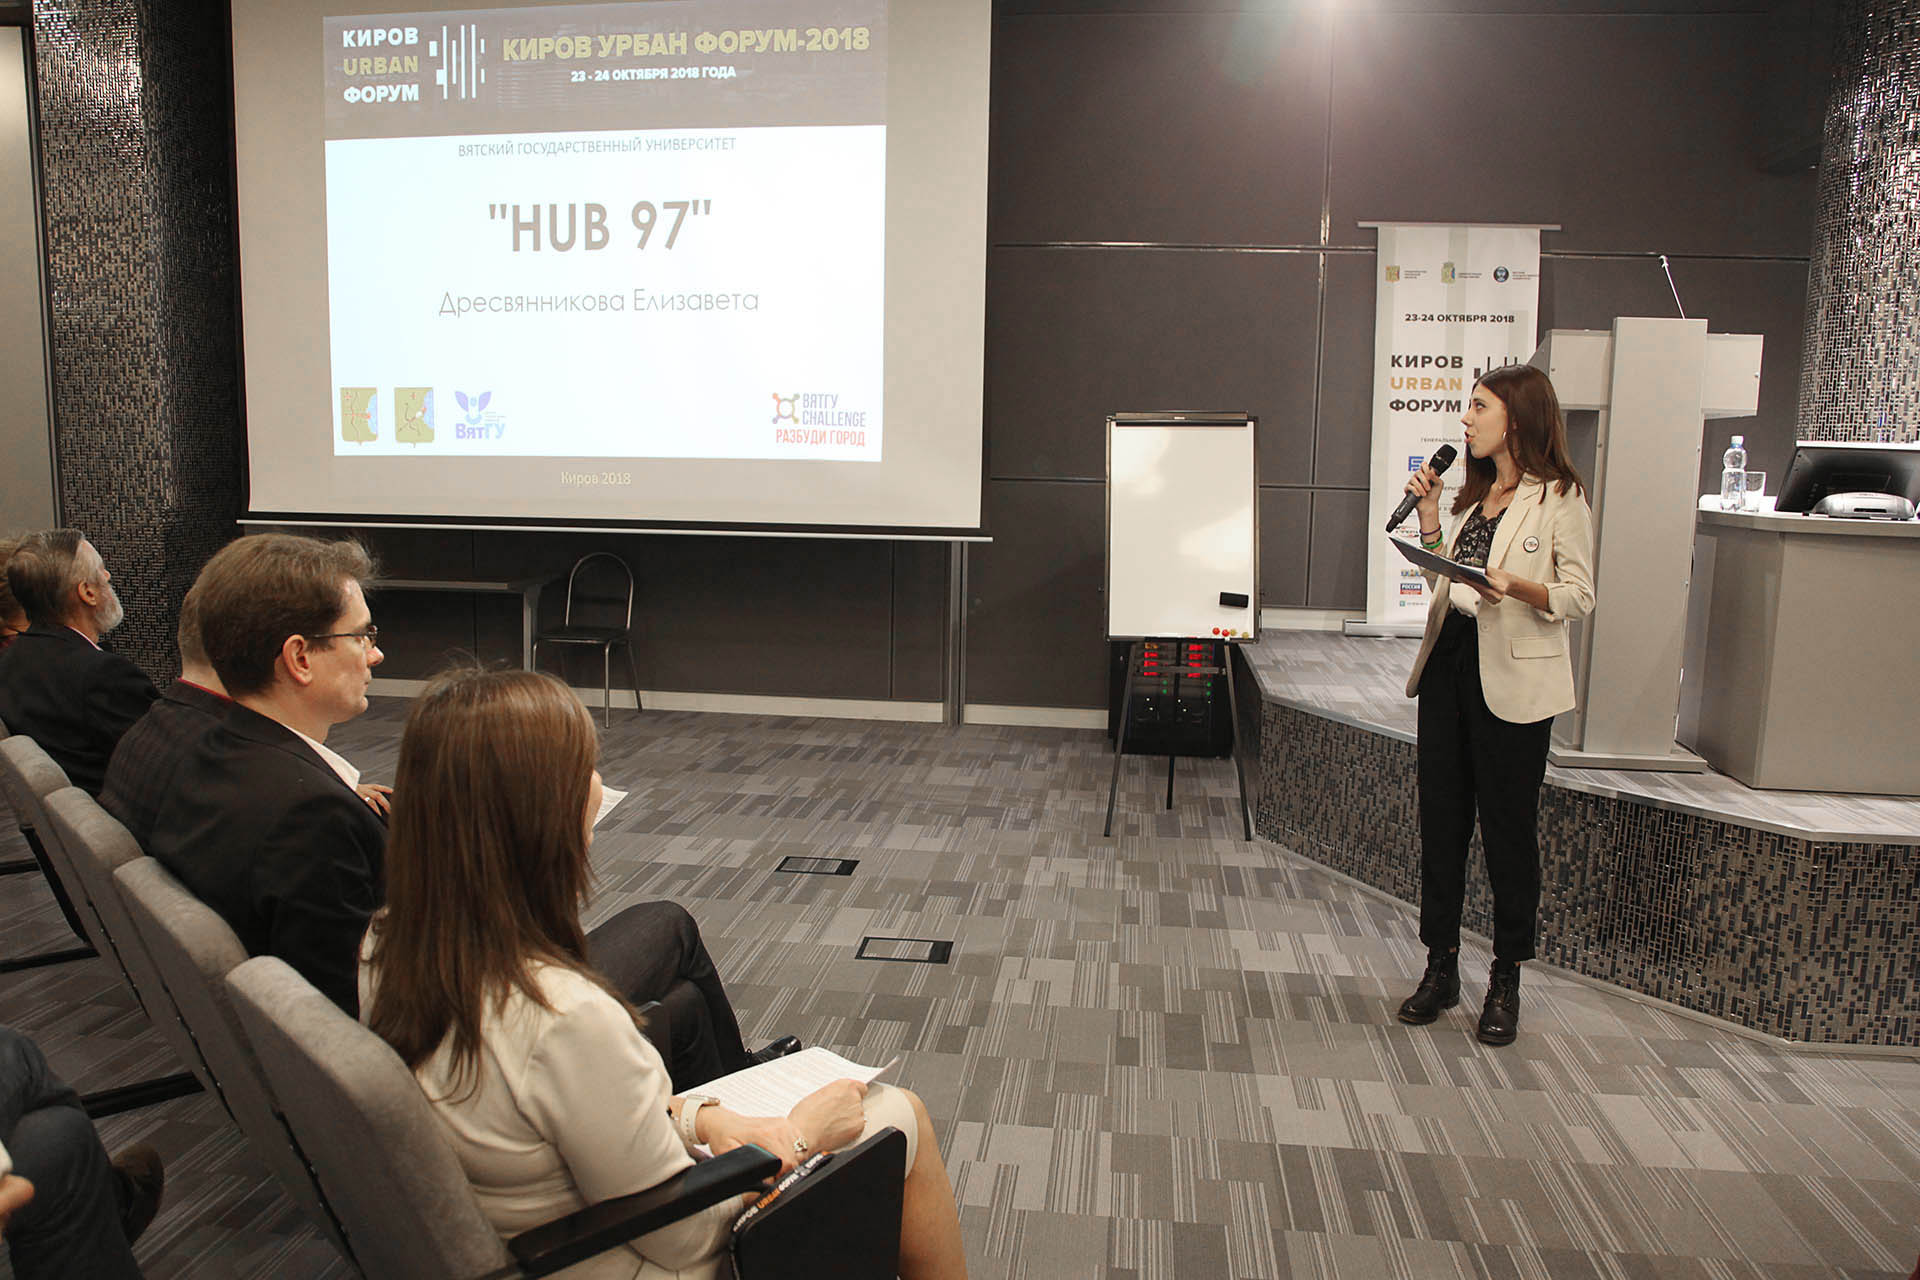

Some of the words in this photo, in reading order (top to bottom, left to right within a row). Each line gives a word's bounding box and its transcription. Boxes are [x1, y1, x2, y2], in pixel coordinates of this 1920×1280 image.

[343, 27, 419, 48] КИРОВ
[502, 38, 592, 61] КИРОВ
[598, 32, 687, 58] УРБАН
[694, 26, 871, 55] ФОРУМ-2018
[343, 55, 419, 76] URBAN
[570, 70, 586, 83] 23
[594, 69, 610, 82] 24
[612, 68, 669, 81] ОКТЯБРЯ
[670, 66, 700, 79] 2018
[702, 65, 737, 80] ГОДА
[343, 84, 420, 103] ФОРУМ
[458, 138, 515, 157] ВЯТСКИЙ
[517, 136, 642, 156] ГОСУДАРСТВЕННЫЙ
[646, 137, 737, 152] УНИВЕРСИТЕТ
[438, 291, 625, 318] Дресвянникова
[633, 288, 759, 312] Елизавета
[1404, 313, 1435, 323] 23-24
[1437, 313, 1487, 323] ОКТЯБРЯ
[1489, 314, 1516, 324] 2018
[1391, 355, 1464, 369] КИРОВ
[1390, 377, 1463, 391] URBAN
[802, 393, 839, 409] ВЯТГУ
[1389, 399, 1462, 413] ФОРУМ
[802, 410, 866, 428] CHALLENGE
[455, 423, 505, 440] ВятГУ
[776, 428, 826, 445] РАЗБУДИ
[830, 430, 866, 447] ГОРОД
[561, 471, 599, 488] Киров
[601, 471, 632, 485] 2018
